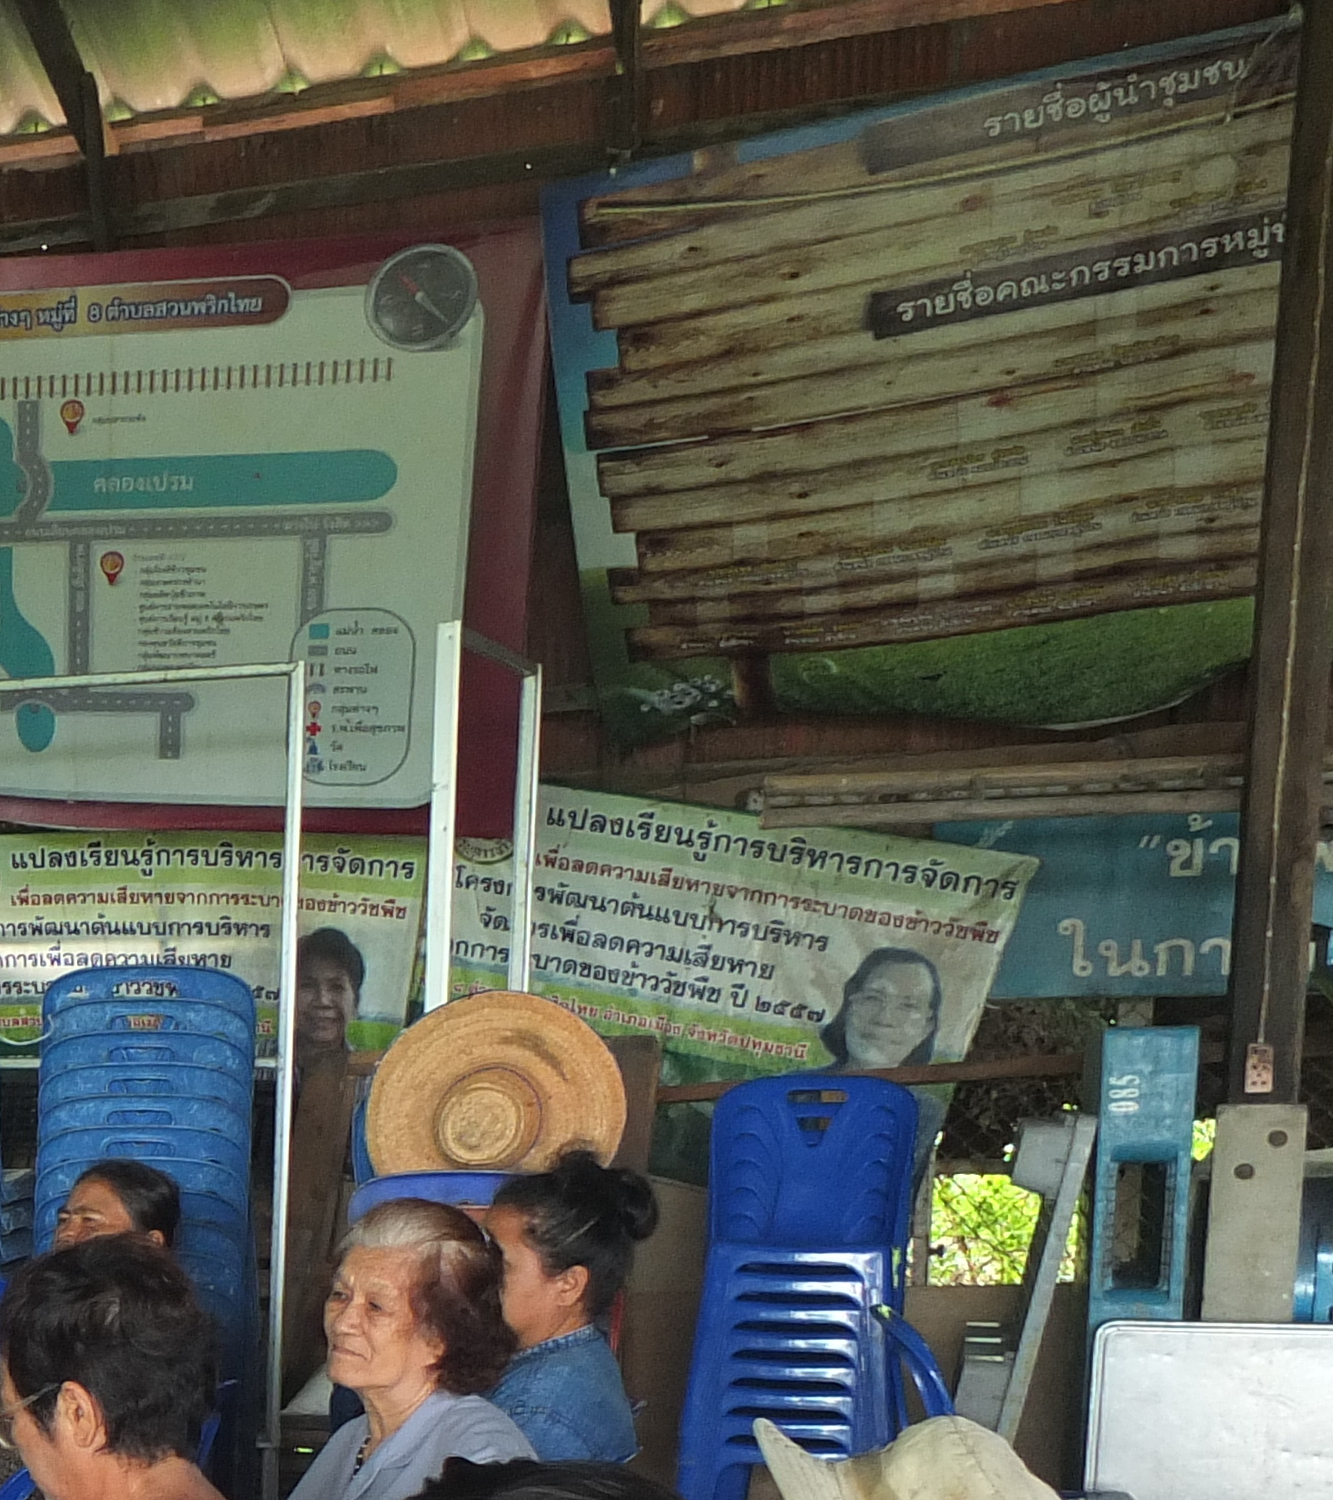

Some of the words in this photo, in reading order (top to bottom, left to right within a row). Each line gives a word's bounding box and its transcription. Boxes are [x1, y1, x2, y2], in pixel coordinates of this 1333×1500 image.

[36, 294, 78, 332] หมู่ที่
[88, 303, 100, 322] 8
[106, 292, 263, 322] ตำบลสวนพริกไทย
[10, 838, 416, 879] แปลงเรียนรู้การบริหารารจัดการ
[546, 802, 1020, 902] แปลงเรียนรู้การบริหารการจัดการ
[731, 979, 748, 1009] ปี
[755, 998, 827, 1026] ๒๕๕๗
[688, 1022, 809, 1061] จังหวัดปทุมธานี
